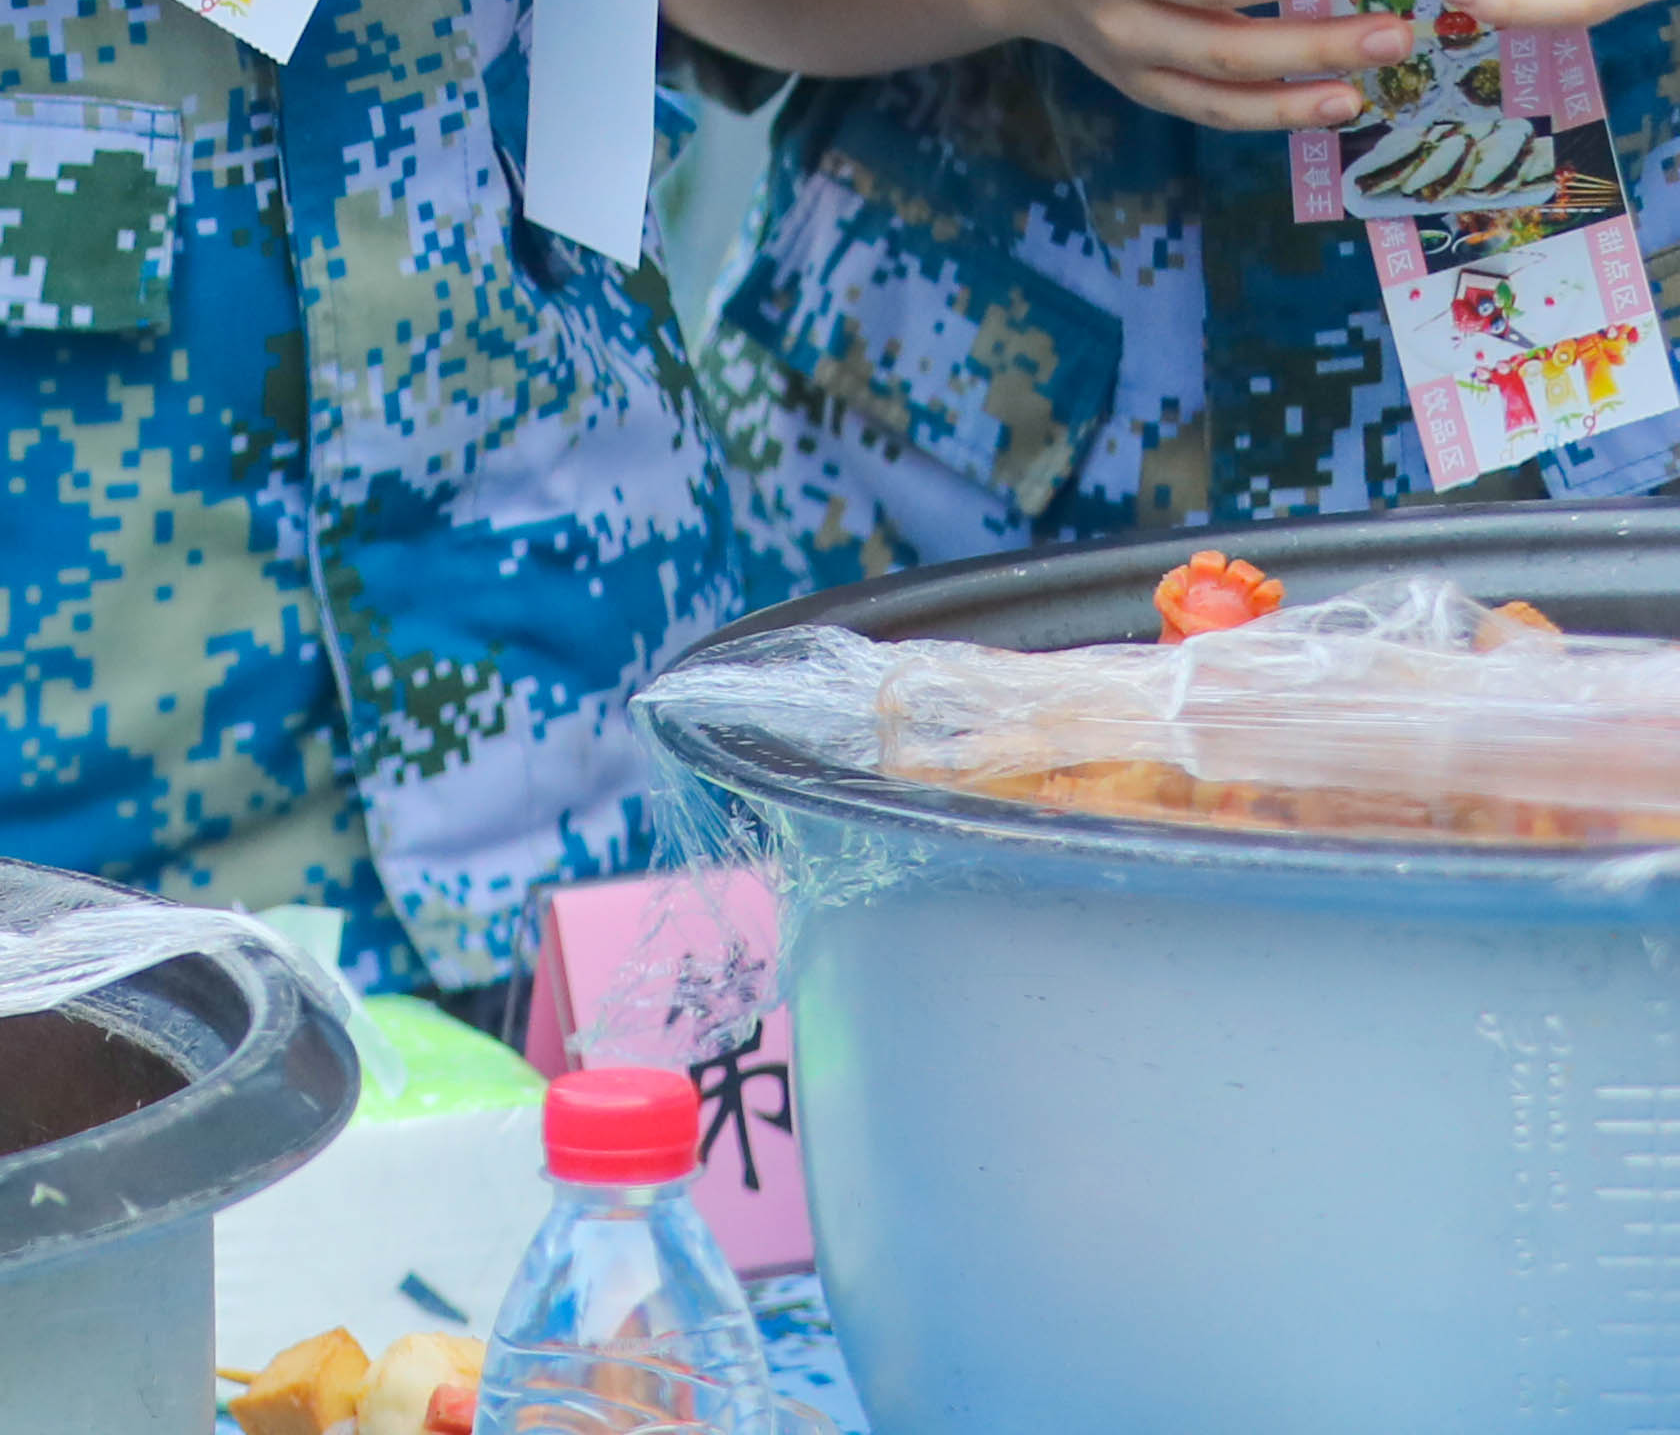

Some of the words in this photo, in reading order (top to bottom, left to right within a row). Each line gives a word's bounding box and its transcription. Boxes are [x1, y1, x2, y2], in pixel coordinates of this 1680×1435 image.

[1511, 34, 1540, 110] 小吃区
[1552, 38, 1593, 120] 水果区
[1303, 140, 1333, 215] 主食区
[1597, 227, 1639, 315] 甜点区
[1421, 386, 1466, 476] 饮品区
